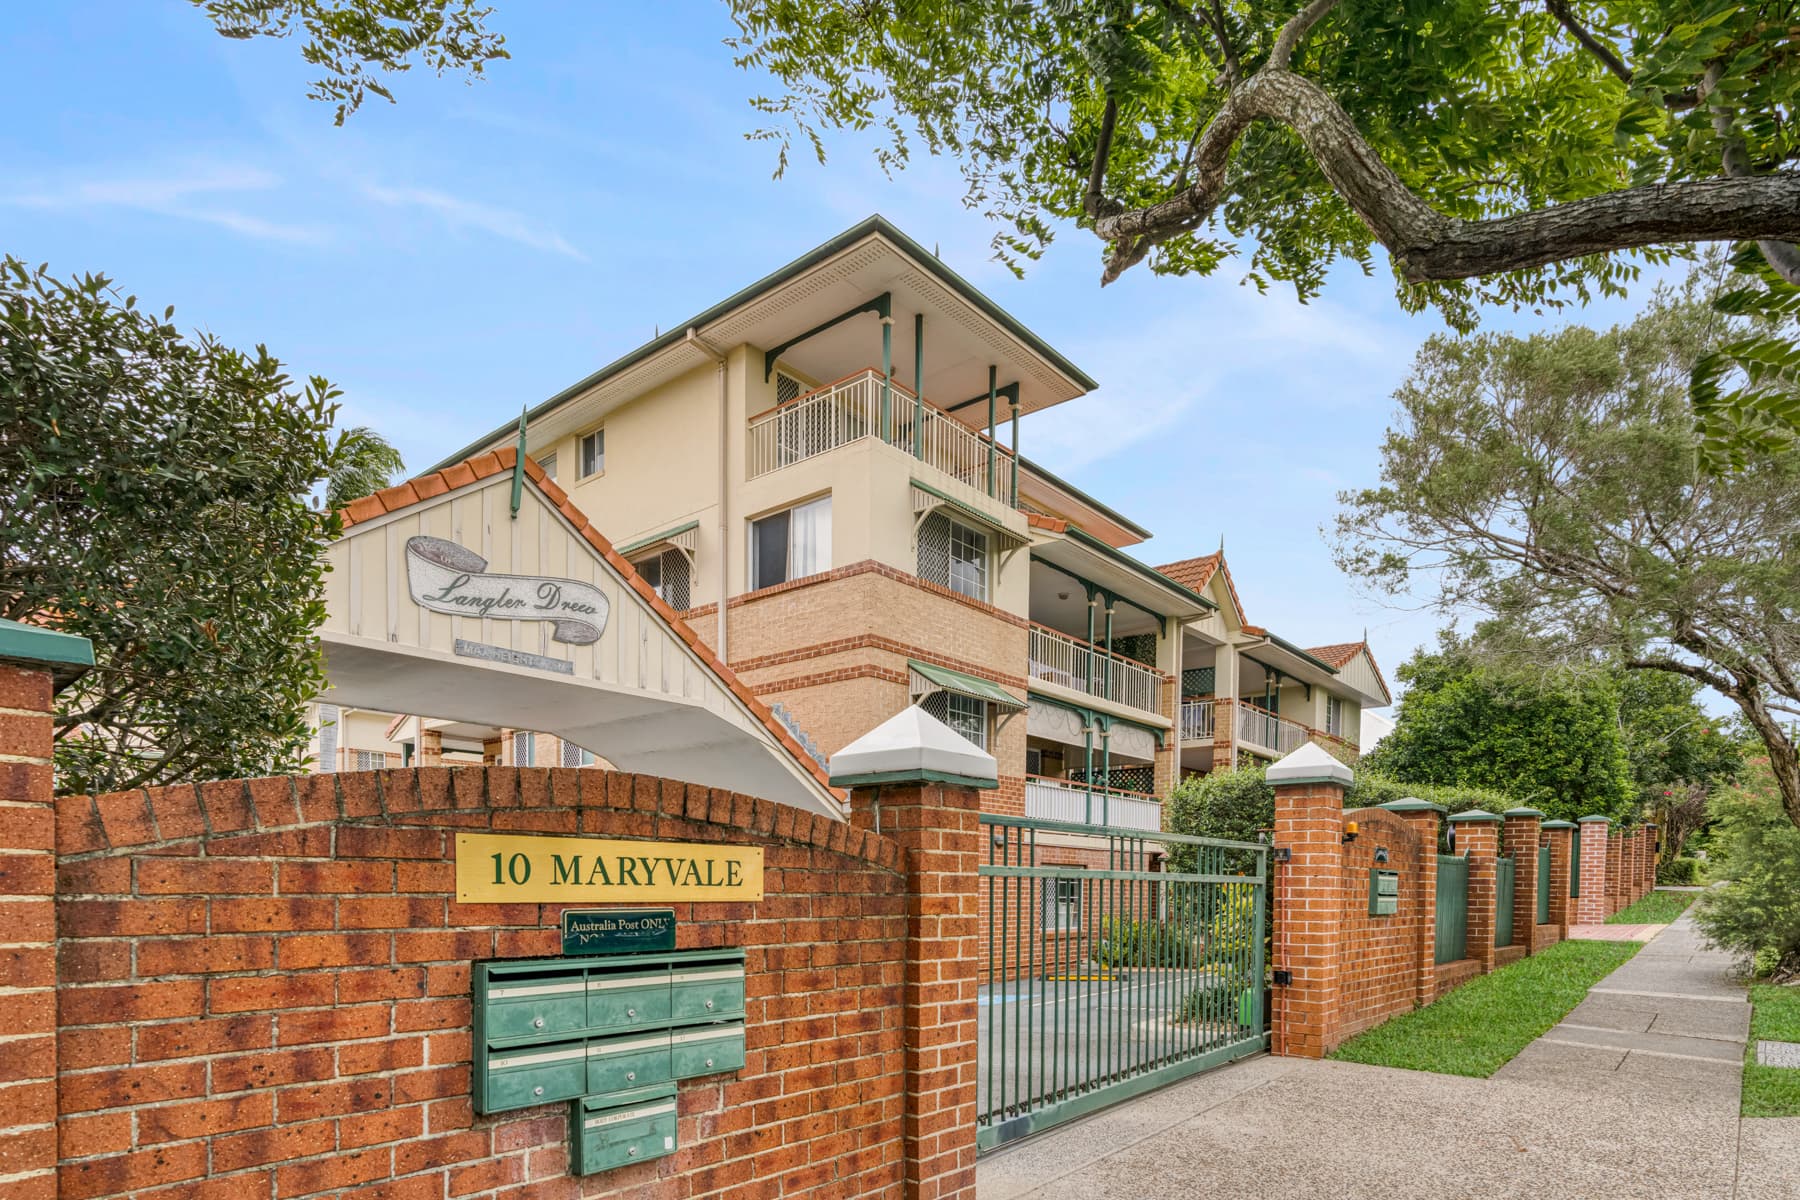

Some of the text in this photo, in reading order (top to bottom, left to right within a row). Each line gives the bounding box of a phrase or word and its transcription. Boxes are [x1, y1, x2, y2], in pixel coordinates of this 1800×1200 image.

[534, 582, 598, 615] Drew
[490, 852, 744, 887] 10 MARYVALE
[570, 917, 670, 932] Australia Post ONLY
